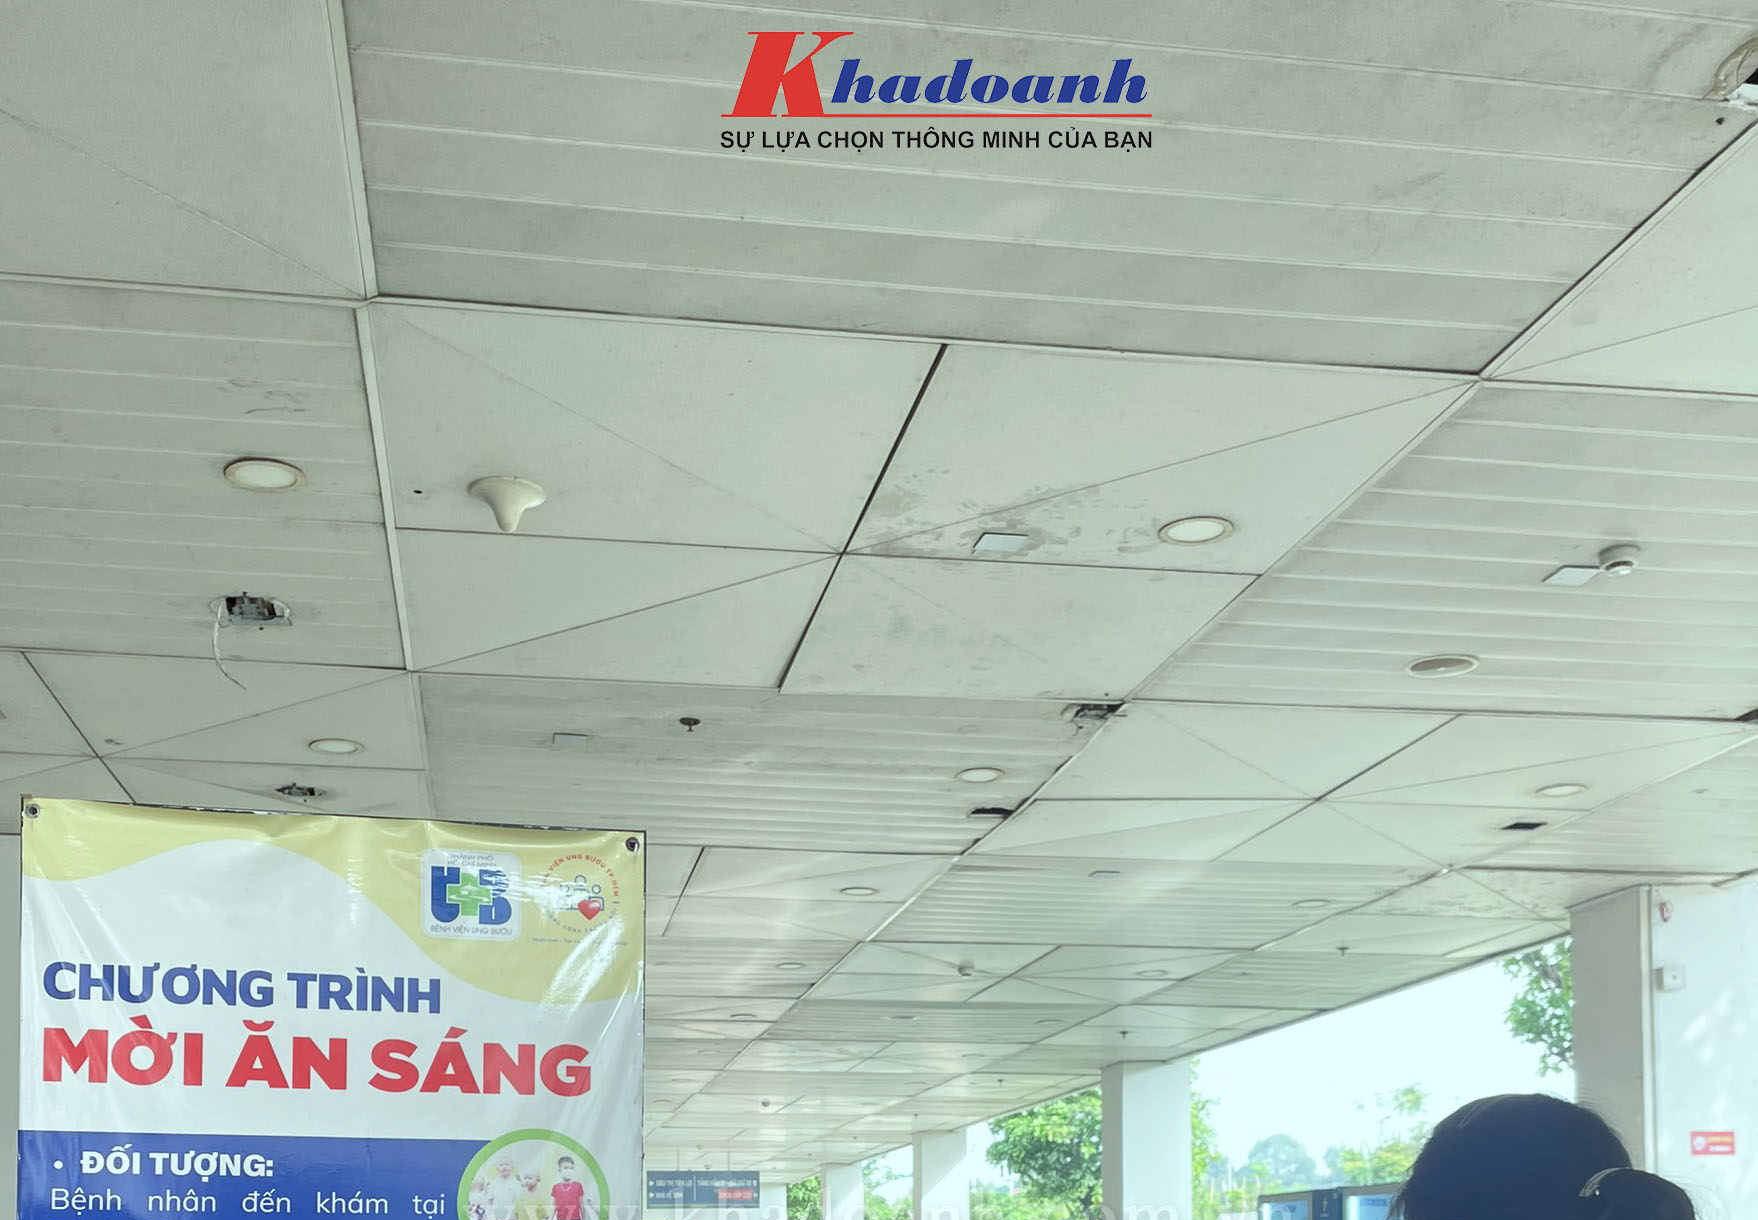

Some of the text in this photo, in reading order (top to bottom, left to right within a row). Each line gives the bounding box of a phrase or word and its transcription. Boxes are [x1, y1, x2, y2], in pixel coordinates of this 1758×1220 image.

[43, 961, 441, 1014] CHƯƠNG TRÌNH
[43, 1014, 592, 1097] MỜI ĂN SÁNG
[80, 1143, 273, 1182] ĐỐI TƯỢNG:
[50, 1186, 445, 1219] Bệnh nhân đến khám tại
